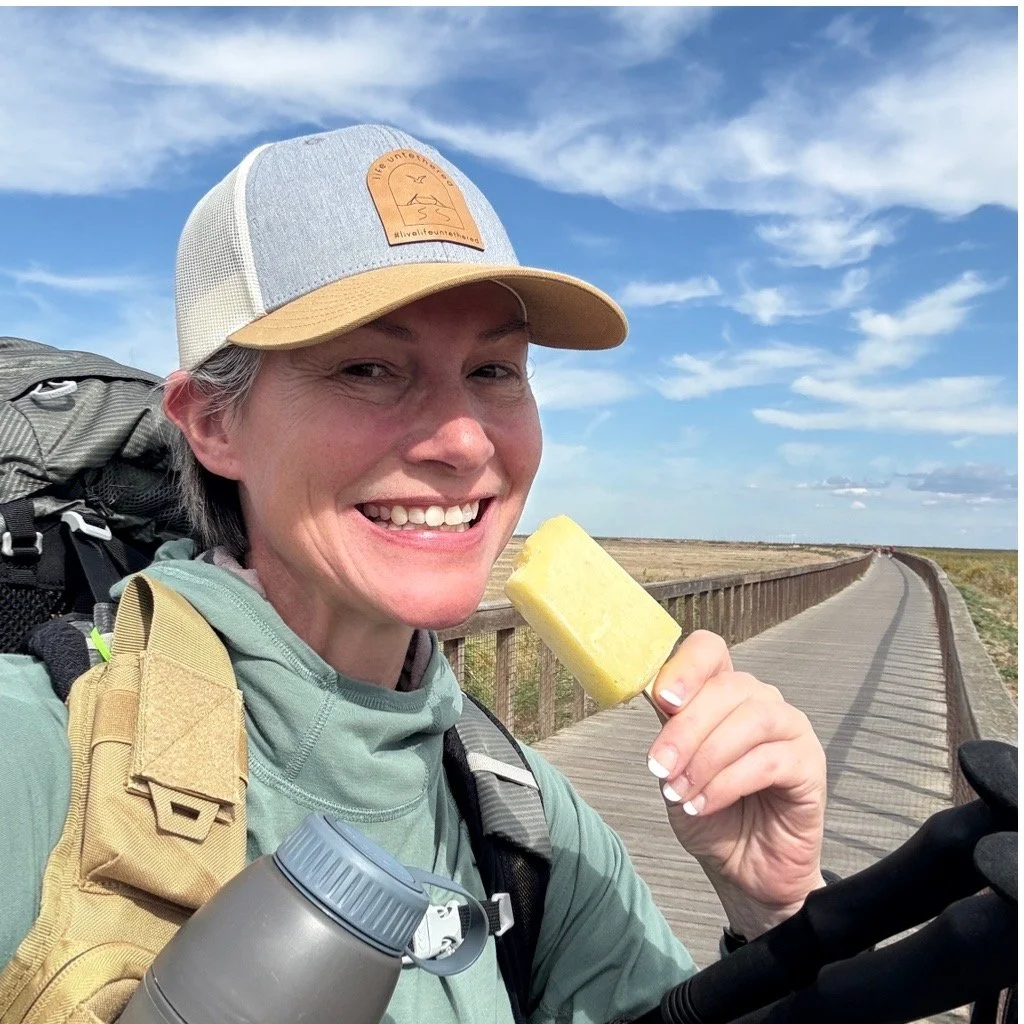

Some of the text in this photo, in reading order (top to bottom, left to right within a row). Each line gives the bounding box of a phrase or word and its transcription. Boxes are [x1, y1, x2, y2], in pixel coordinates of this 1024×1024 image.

[371, 151, 454, 188] life untethered
[394, 227, 481, 245] #livelifeuntethered
